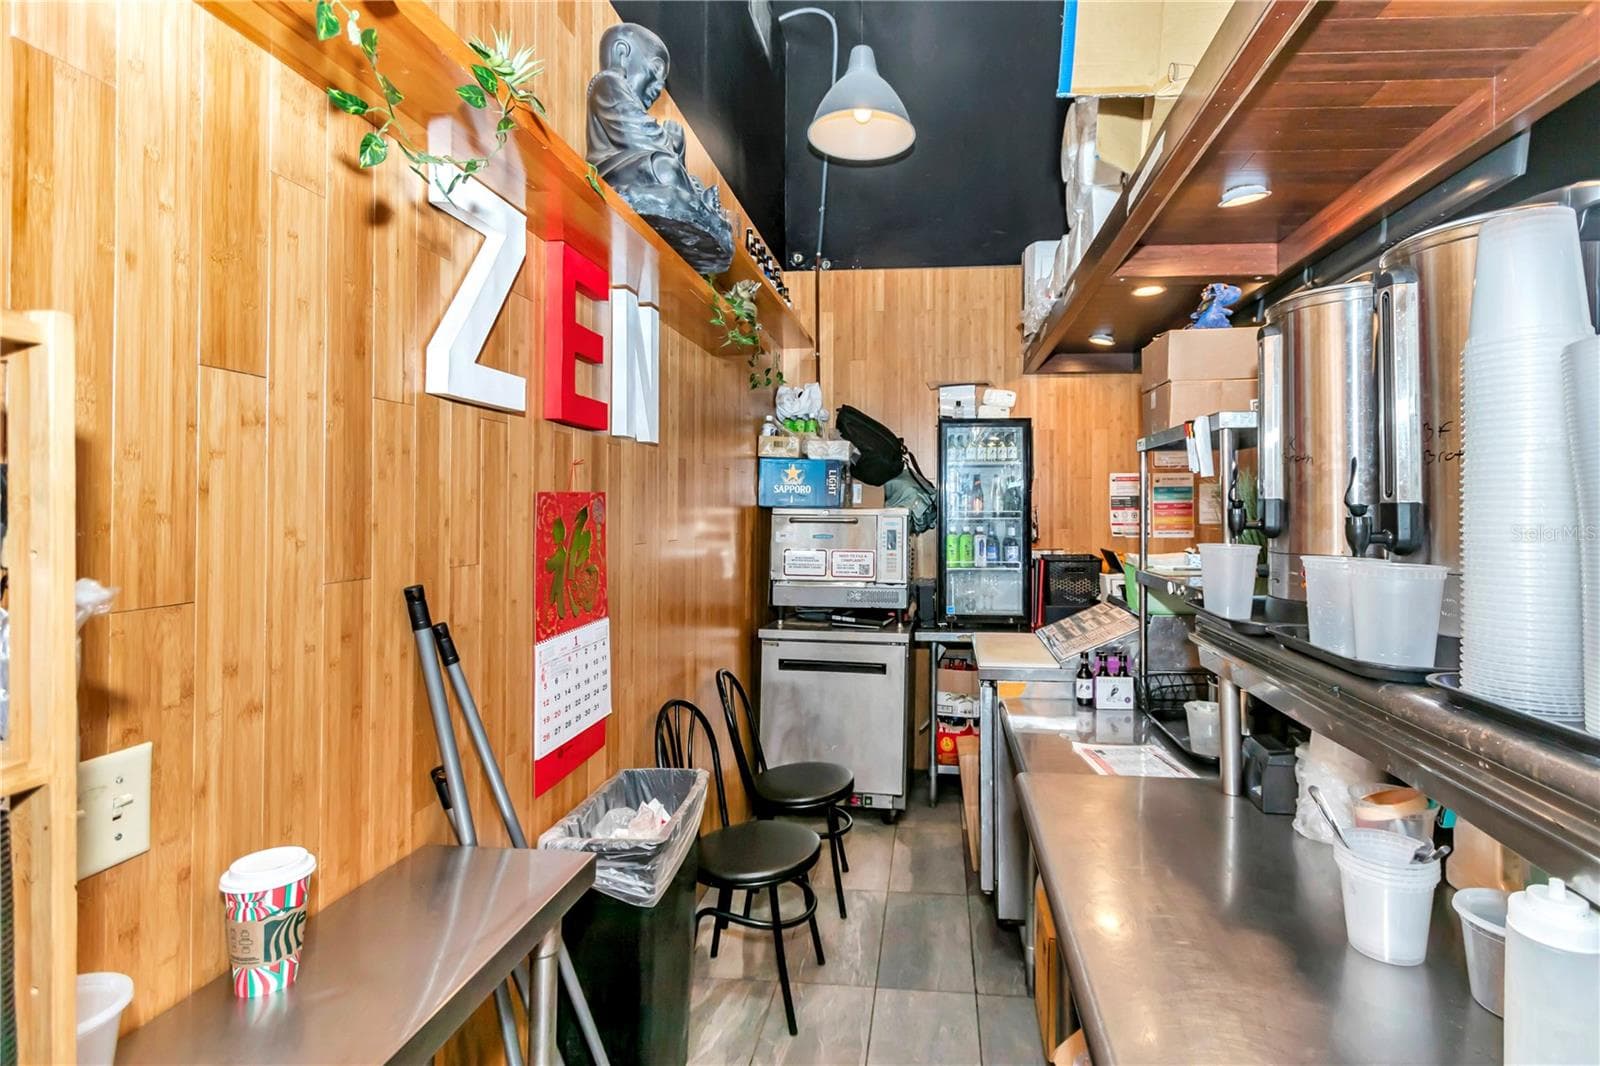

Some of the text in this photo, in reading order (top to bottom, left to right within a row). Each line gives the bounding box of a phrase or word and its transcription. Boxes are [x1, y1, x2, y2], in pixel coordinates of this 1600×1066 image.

[425, 160, 660, 445] ZEN
[773, 484, 812, 494] SAPPORO
[828, 469, 837, 496] LIGHT
[543, 699, 550, 707] 12
[554, 693, 561, 702] 13
[565, 688, 571, 696] 14
[554, 710, 561, 718] 20
[565, 704, 571, 712] 21
[575, 698, 581, 706] 22
[584, 693, 591, 701] 23
[593, 688, 600, 696] 24
[554, 726, 561, 735] 27
[565, 720, 572, 729] 28
[575, 713, 581, 722] 29
[584, 708, 591, 717] 30
[593, 703, 600, 711] 31
